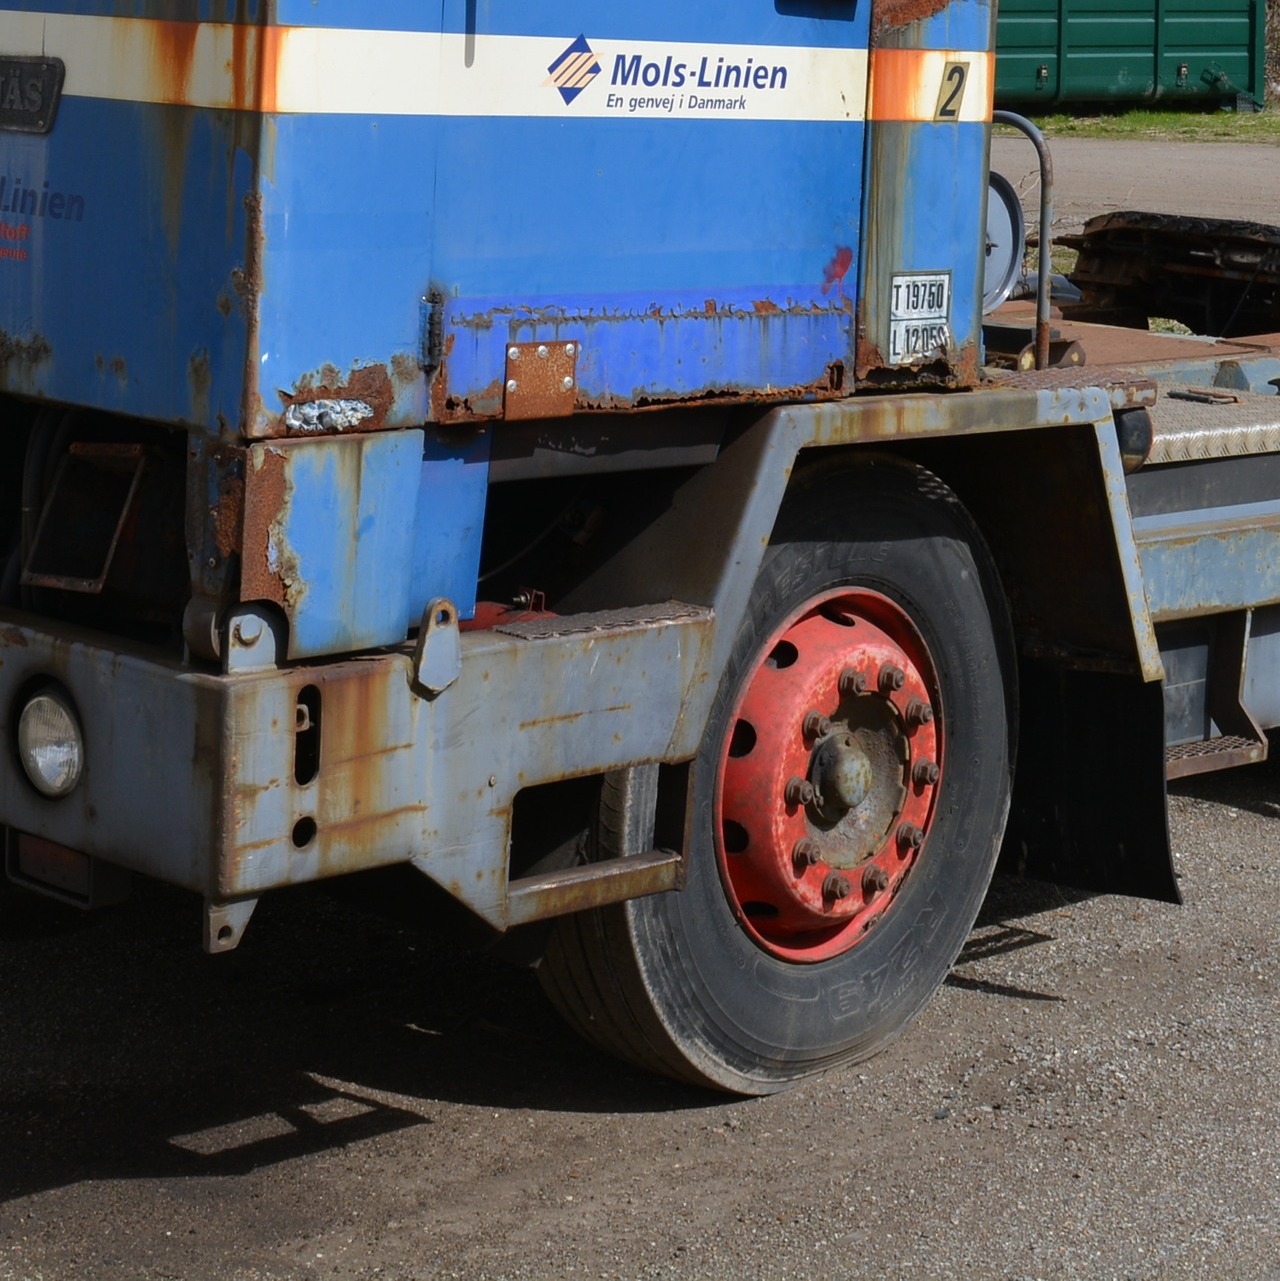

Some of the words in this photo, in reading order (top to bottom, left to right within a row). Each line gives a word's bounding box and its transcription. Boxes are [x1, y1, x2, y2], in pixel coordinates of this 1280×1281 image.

[610, 54, 788, 89] Mols-Linien
[606, 93, 624, 108] En
[628, 94, 675, 112] genvej
[688, 95, 747, 110] Danmark
[939, 64, 965, 117] 2
[893, 284, 902, 311] T
[905, 283, 944, 311] 19750
[892, 329, 901, 356] L
